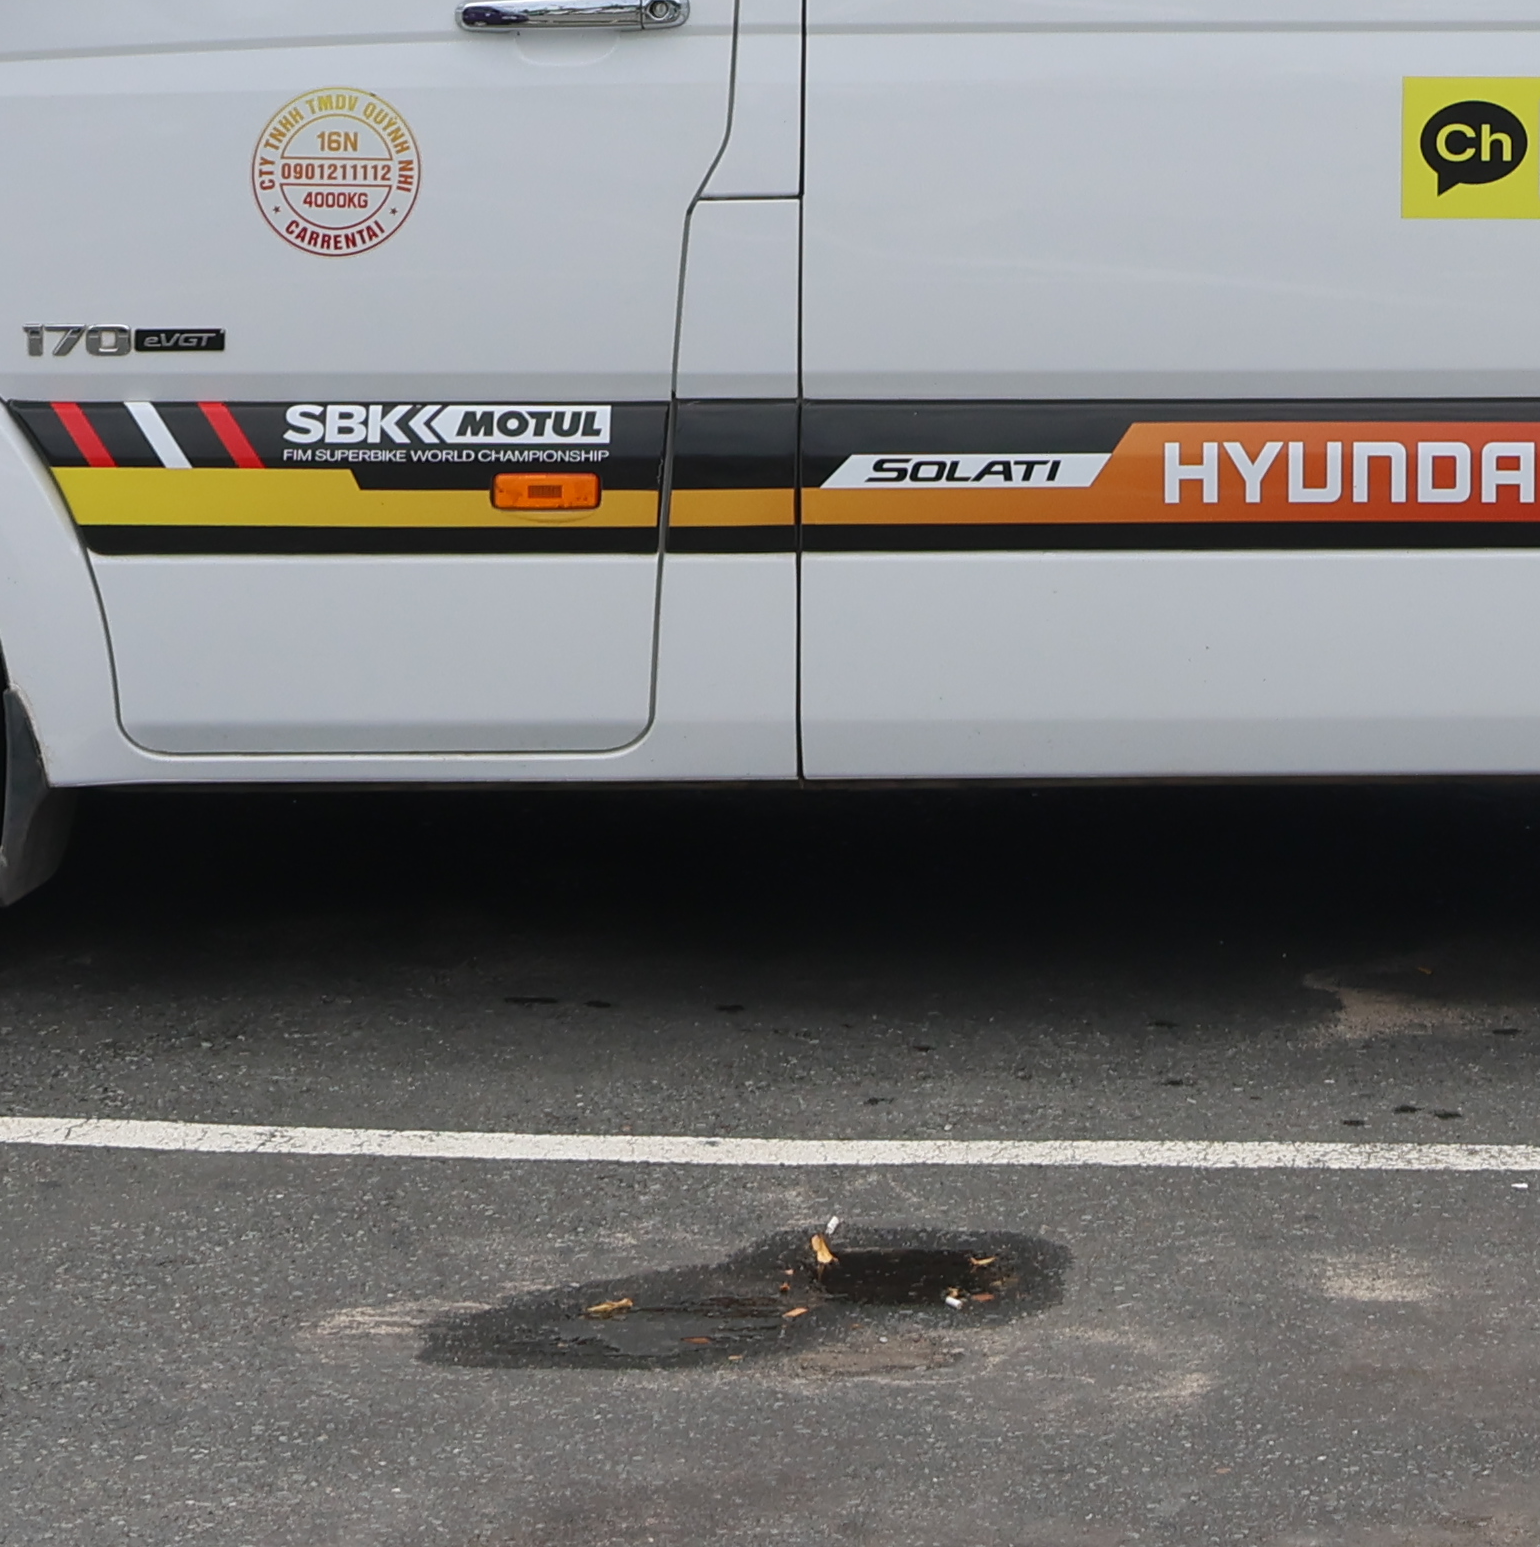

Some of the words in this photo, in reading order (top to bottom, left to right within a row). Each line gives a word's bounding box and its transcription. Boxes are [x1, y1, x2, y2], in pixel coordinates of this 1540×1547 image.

[305, 94, 358, 114] TMDV
[264, 108, 304, 151] TNHH
[316, 131, 358, 152] 16N
[1435, 123, 1513, 163] Ch
[259, 157, 276, 191] CTY
[281, 162, 391, 181] 0901211112
[396, 159, 414, 193] NHI
[302, 192, 369, 209] 4000KG
[22, 324, 131, 356] 170
[144, 333, 217, 347] eVGT
[283, 405, 413, 444] SBK
[455, 410, 603, 437] MOTUL
[283, 448, 311, 462] FIM
[315, 448, 407, 463] SUPERBIKE
[410, 448, 475, 463] WORLD
[477, 448, 610, 463] CHAMPIONSHIP
[864, 458, 1061, 483] SOLATI
